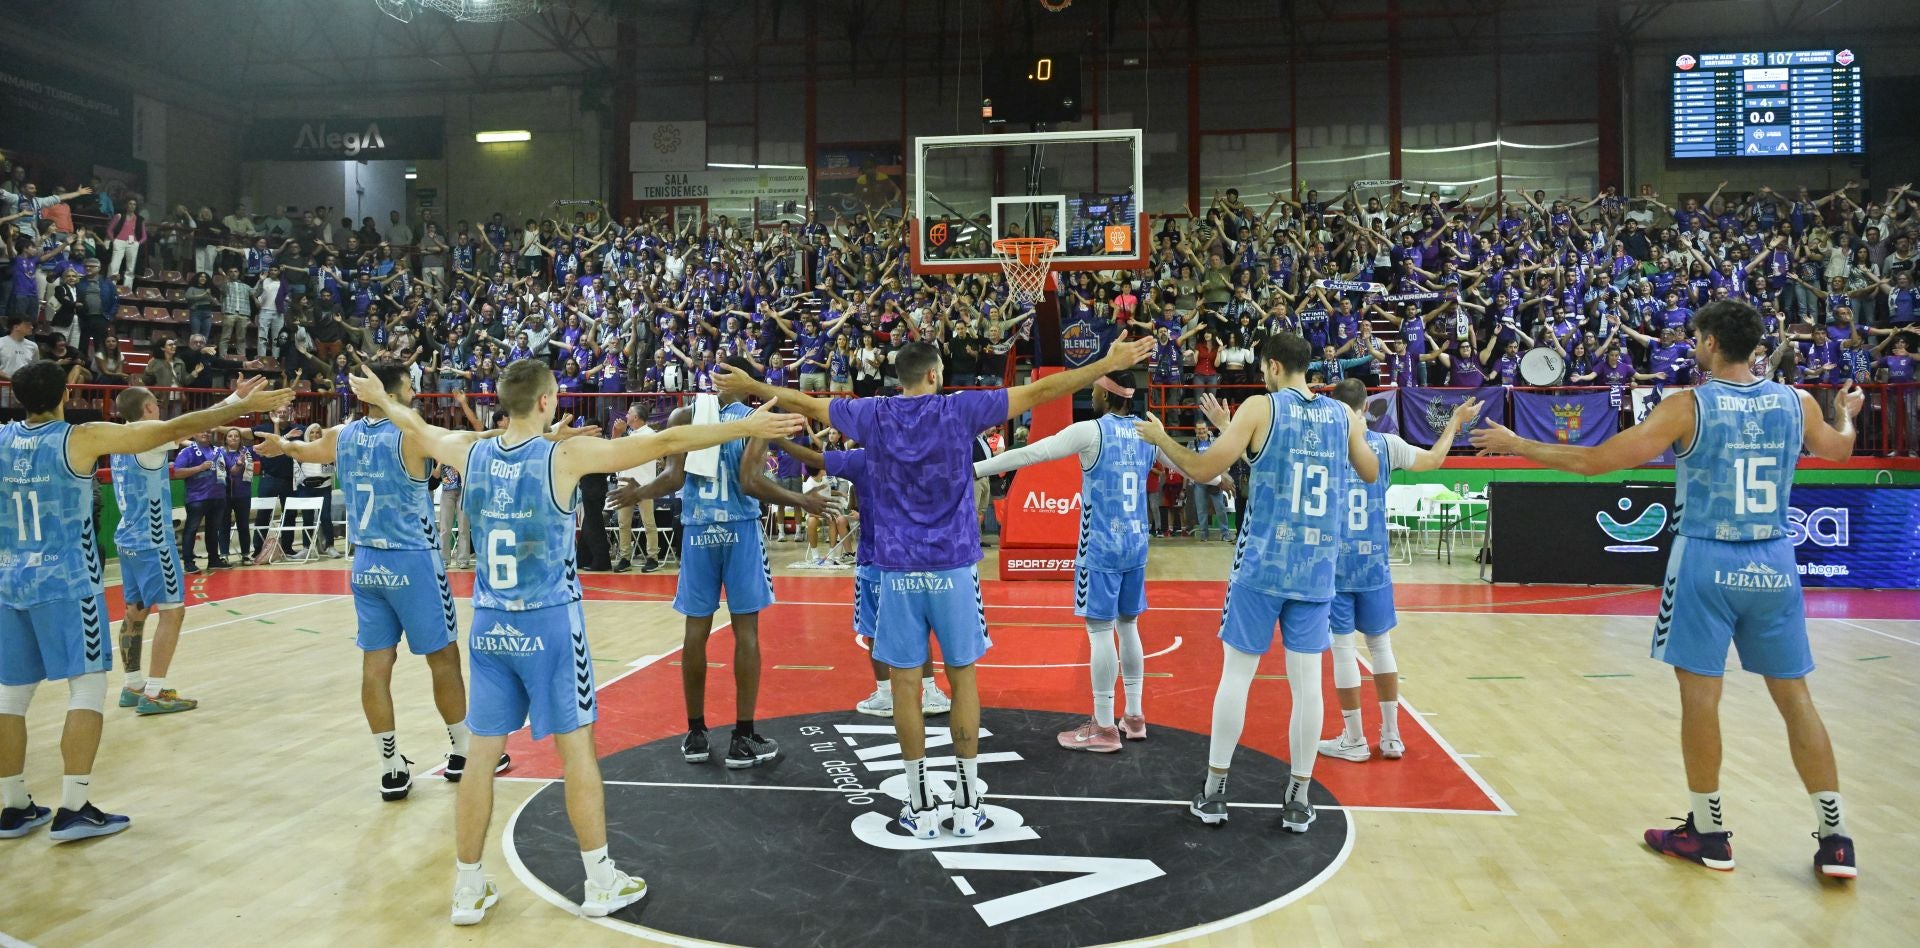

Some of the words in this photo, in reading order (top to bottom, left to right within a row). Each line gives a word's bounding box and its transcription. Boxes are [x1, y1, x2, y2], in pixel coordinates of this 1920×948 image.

[1742, 53, 1758, 65] 58
[1768, 53, 1793, 65] 107
[1750, 111, 1775, 123] 0.0
[293, 122, 386, 157] AlegA
[664, 174, 689, 186] SALA
[644, 186, 671, 198] TENIS
[683, 185, 709, 197] MESA
[1383, 292, 1439, 302] VOLVEREMOS
[1064, 339, 1098, 349] ALENCIA
[1716, 394, 1782, 412] GONZALEZ
[1762, 440, 1785, 450] salud
[490, 459, 521, 479] BORG
[1122, 471, 1138, 512] 9
[1291, 461, 1329, 517] 13
[1733, 456, 1777, 515] 15
[356, 483, 375, 531] 7
[1023, 491, 1083, 515] AlegA
[1348, 488, 1368, 531] 8
[12, 490, 42, 541] 11
[690, 533, 740, 547] LEBANZA
[488, 529, 518, 590] 6
[1008, 559, 1076, 569] SPORTSYST
[1807, 562, 1849, 577] hogar.
[352, 572, 410, 587] LEBANZA
[891, 577, 954, 591] LEBANZA
[1714, 570, 1793, 588] LEBANZA
[472, 635, 545, 652] LEBANZA
[799, 726, 826, 737] es
[809, 741, 836, 753] tu
[821, 759, 875, 806] derecho
